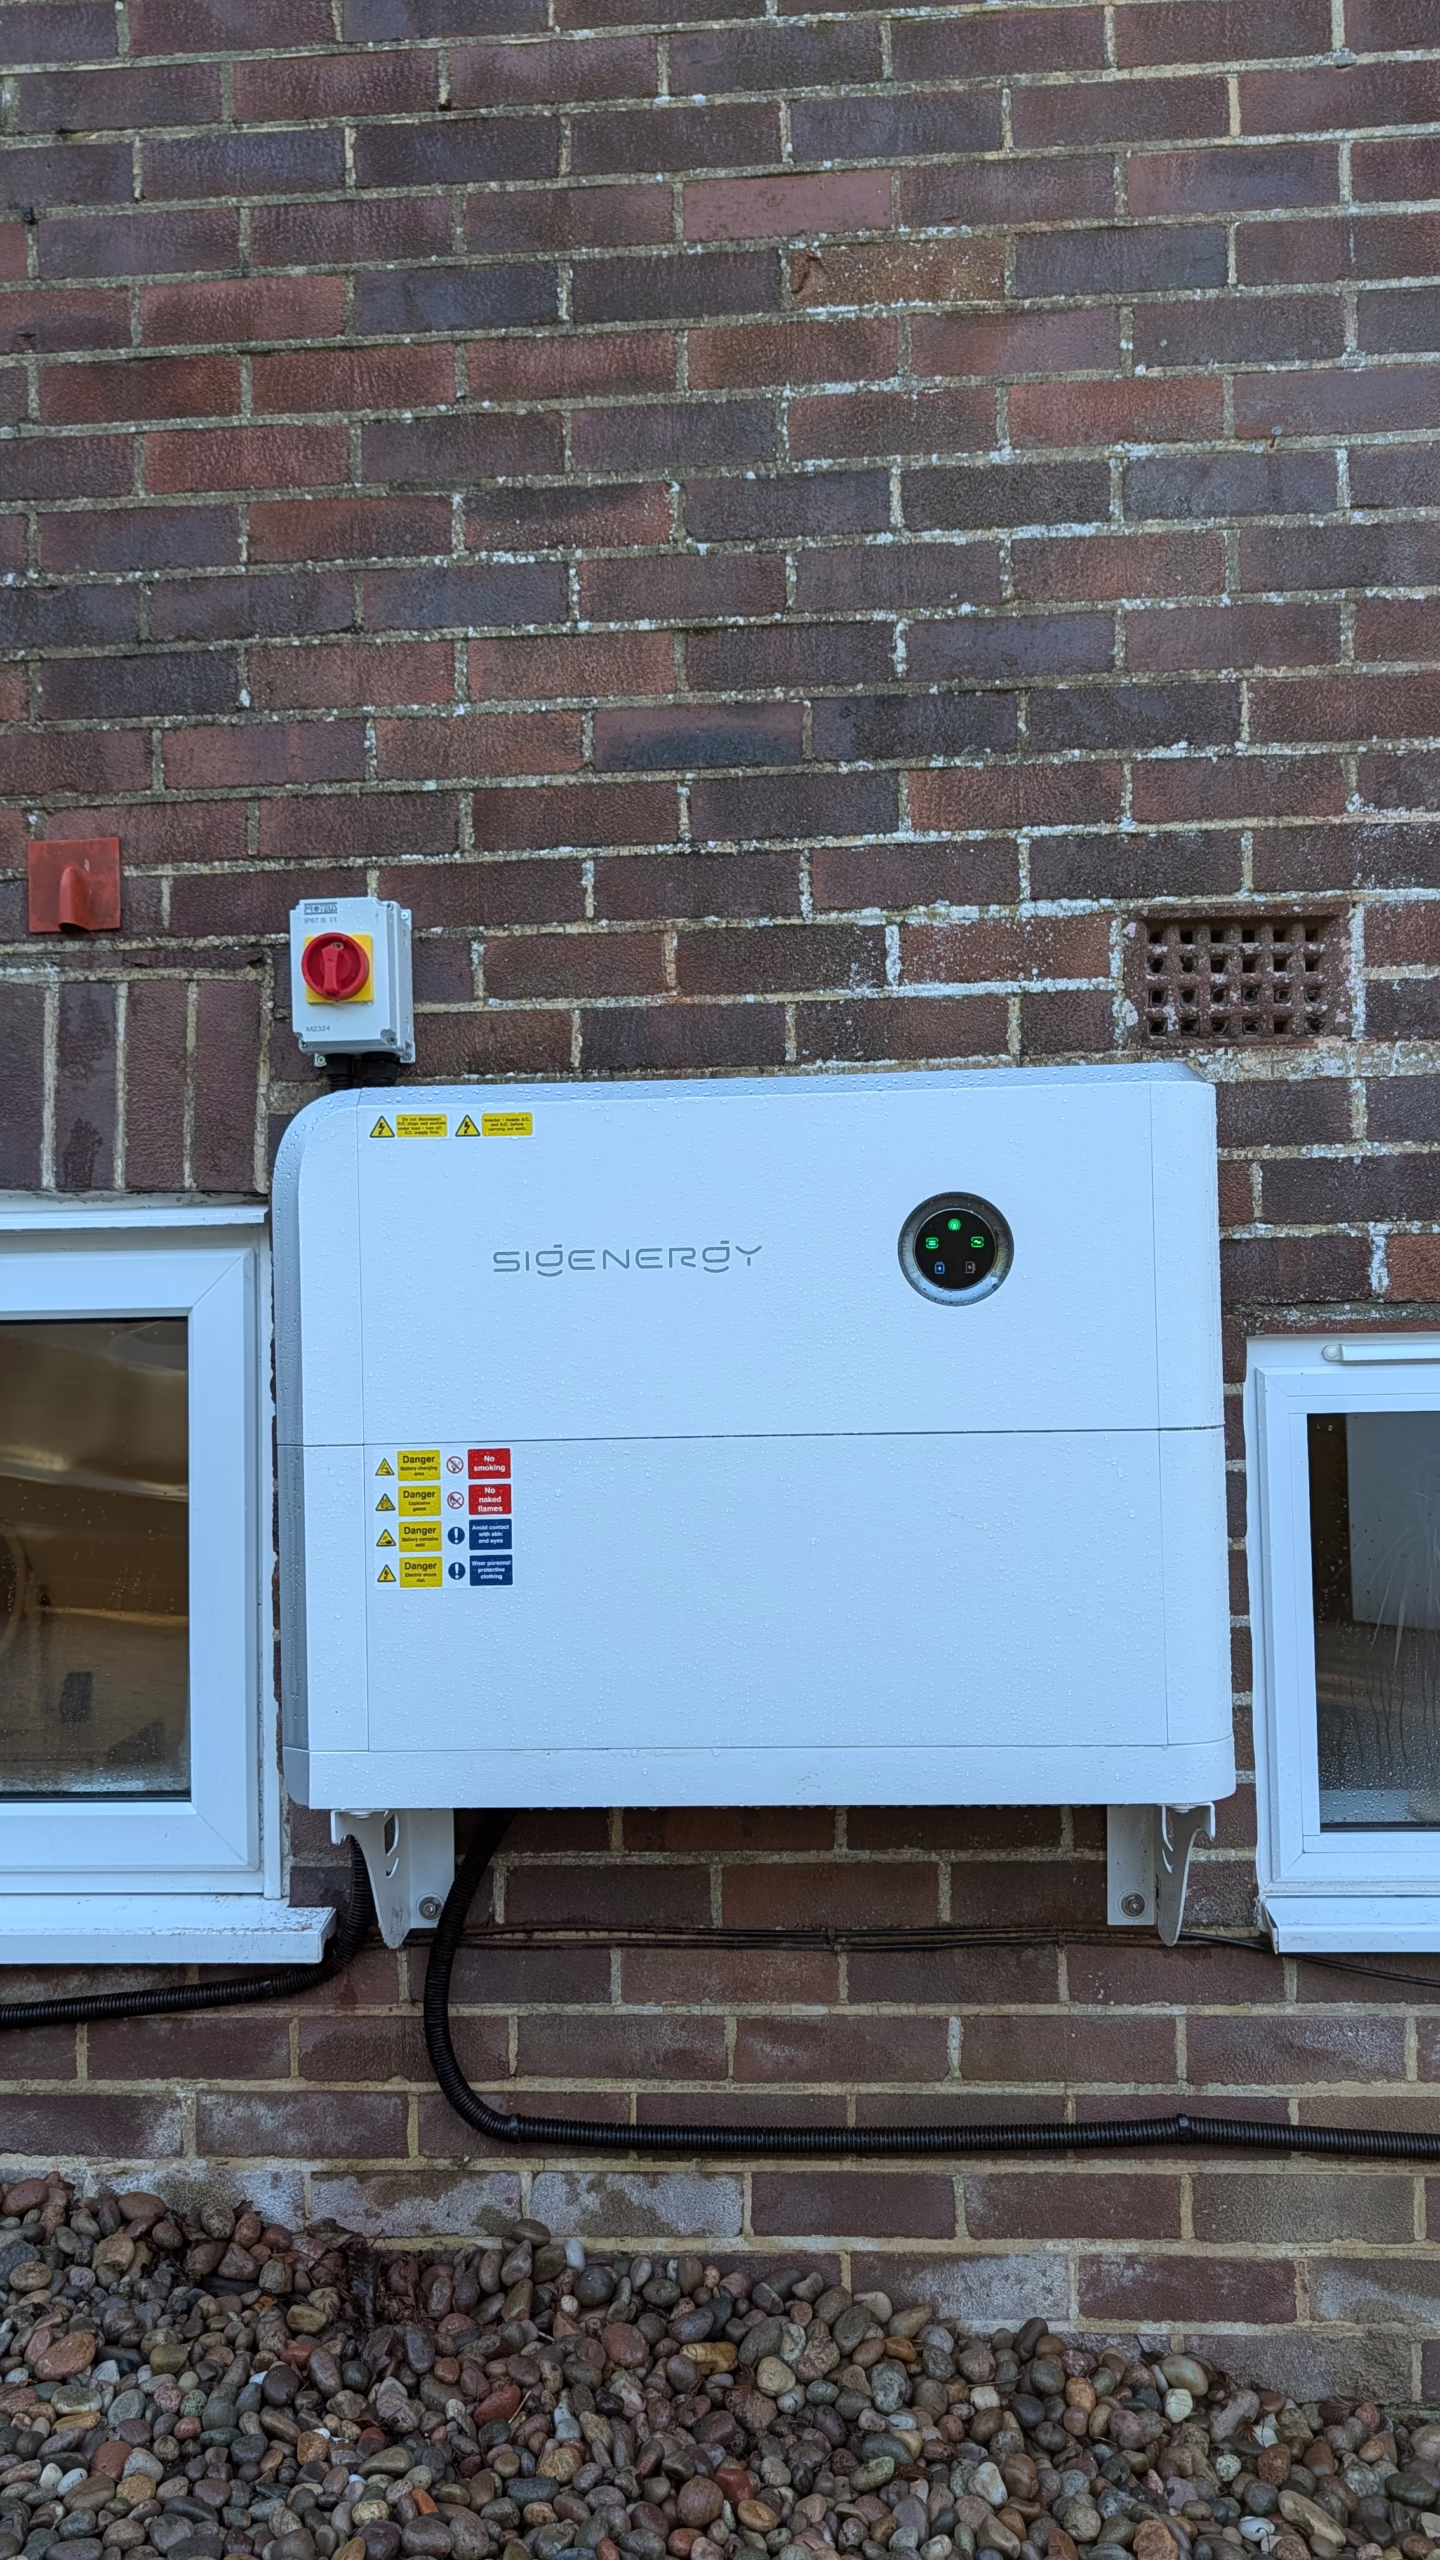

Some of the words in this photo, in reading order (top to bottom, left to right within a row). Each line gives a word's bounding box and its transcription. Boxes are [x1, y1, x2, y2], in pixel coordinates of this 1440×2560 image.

[304, 902, 338, 915] PROTEUS
[306, 1025, 330, 1033] M2324
[402, 1455, 436, 1465] Danger
[473, 1464, 506, 1472] smoking
[403, 1490, 436, 1500] Danger
[403, 1526, 437, 1536] Danger
[404, 1562, 438, 1571] Danger
